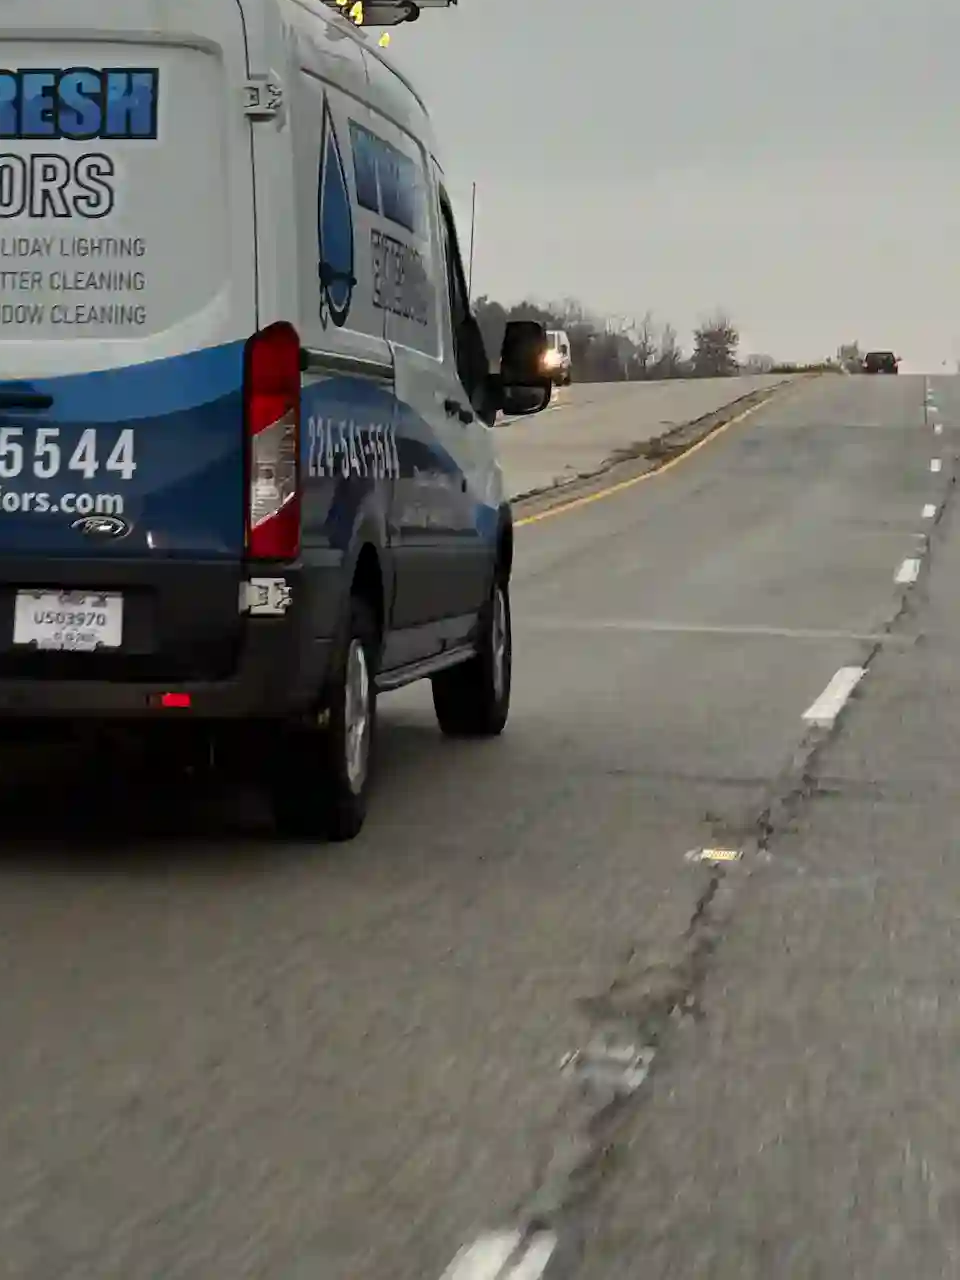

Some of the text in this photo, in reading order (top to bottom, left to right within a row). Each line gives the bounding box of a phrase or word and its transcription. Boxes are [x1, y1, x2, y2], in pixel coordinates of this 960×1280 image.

[59, 238, 146, 257] LIGHTING
[49, 272, 146, 291] CLEANING
[49, 305, 147, 325] CLEANING
